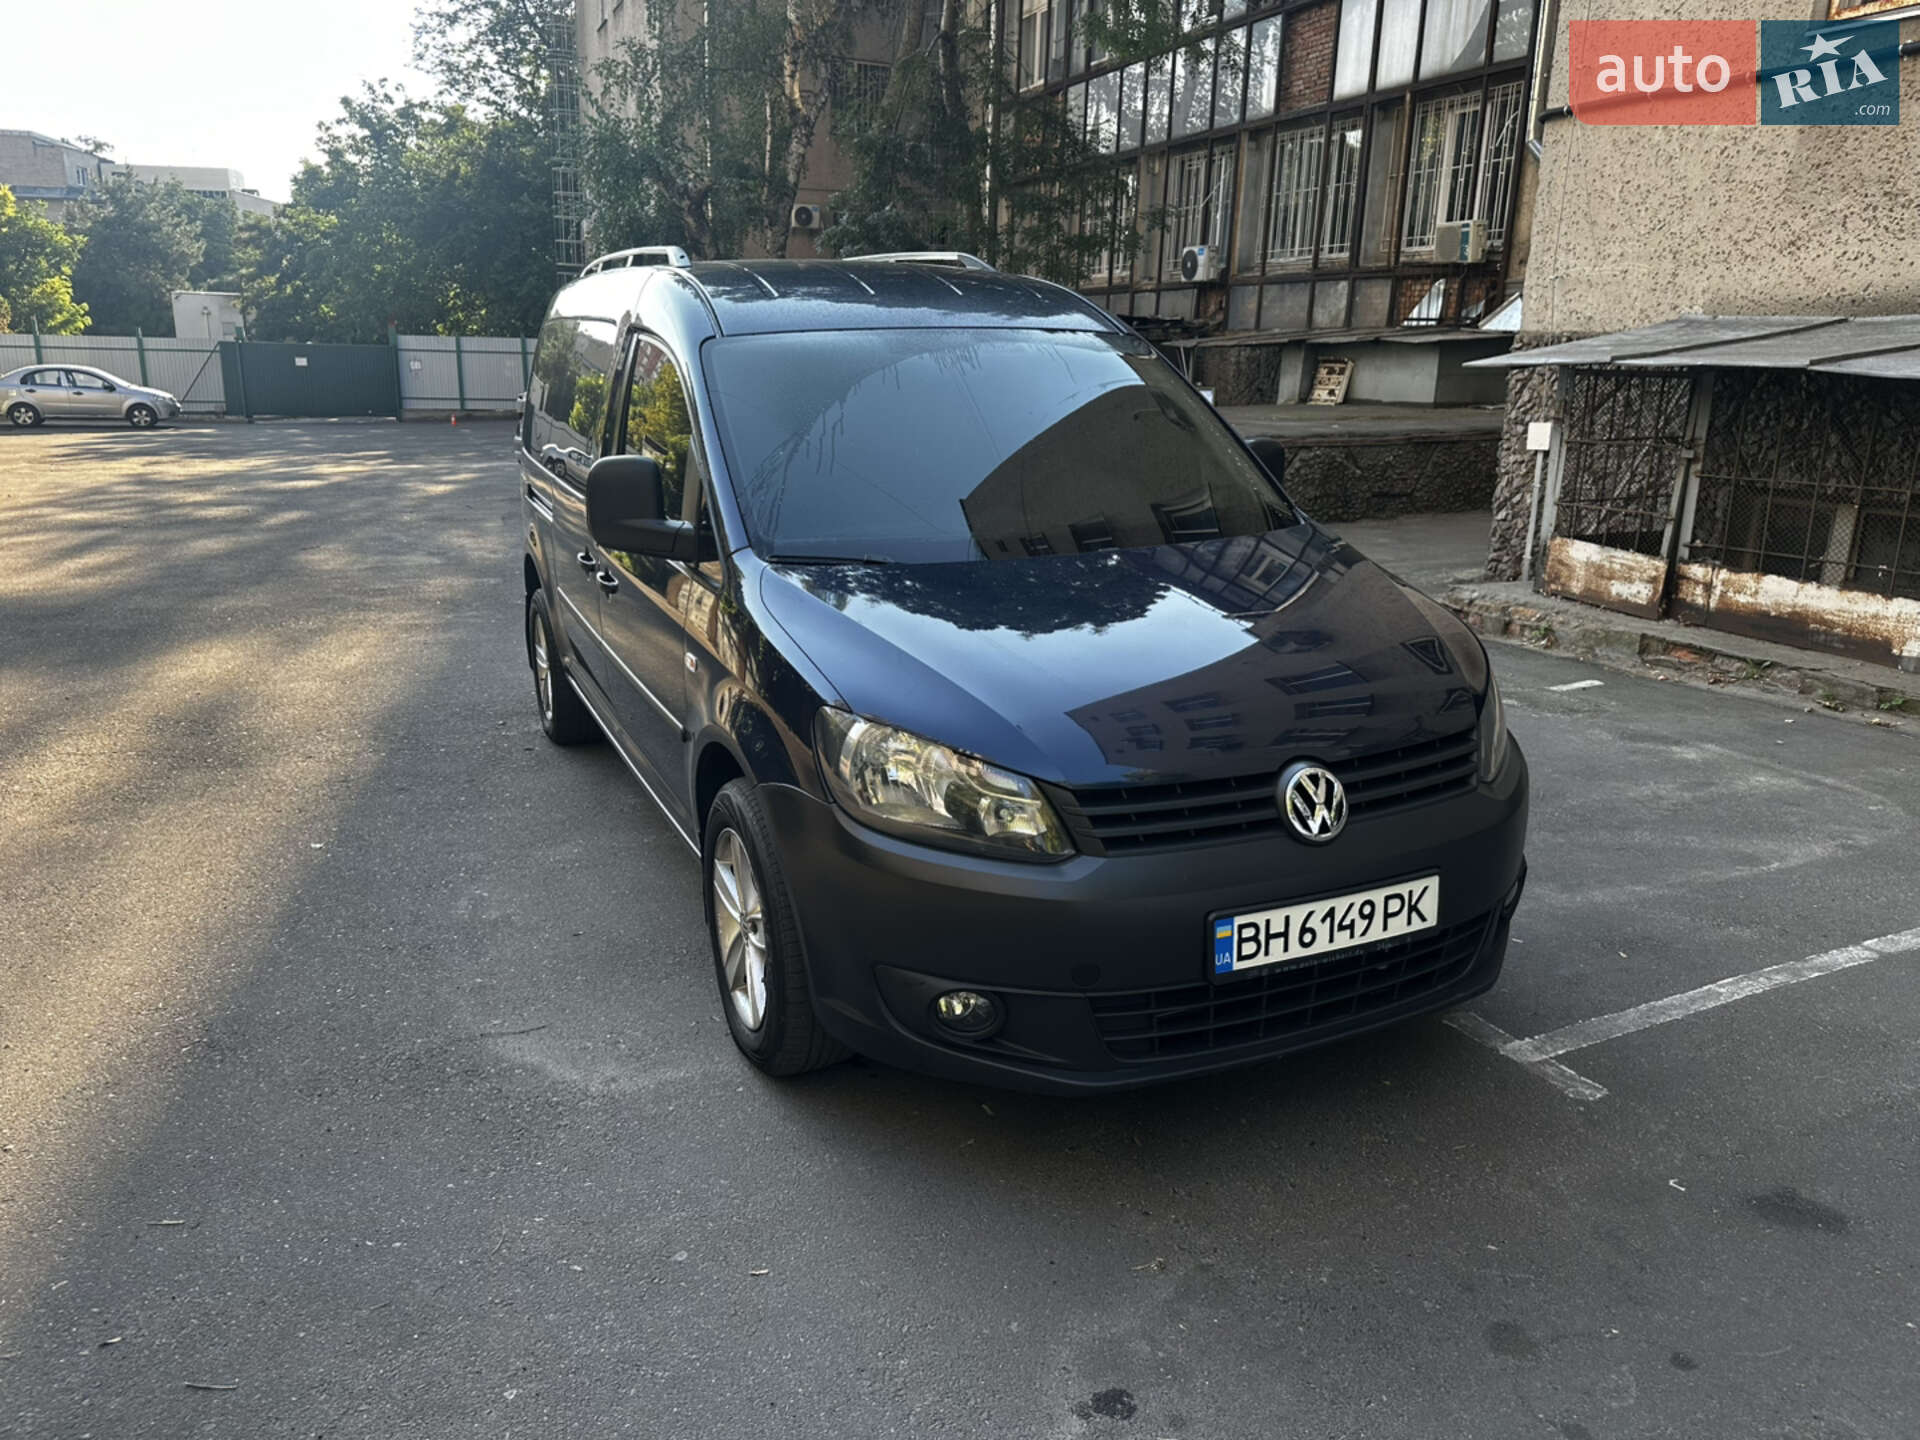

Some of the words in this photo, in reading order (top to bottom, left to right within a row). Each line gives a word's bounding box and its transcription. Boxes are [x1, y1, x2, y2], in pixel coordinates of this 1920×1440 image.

[1236, 915, 1291, 963] BH
[1298, 899, 1376, 949] 6149
[1382, 885, 1430, 932] PK
[1215, 951, 1232, 966] UA
